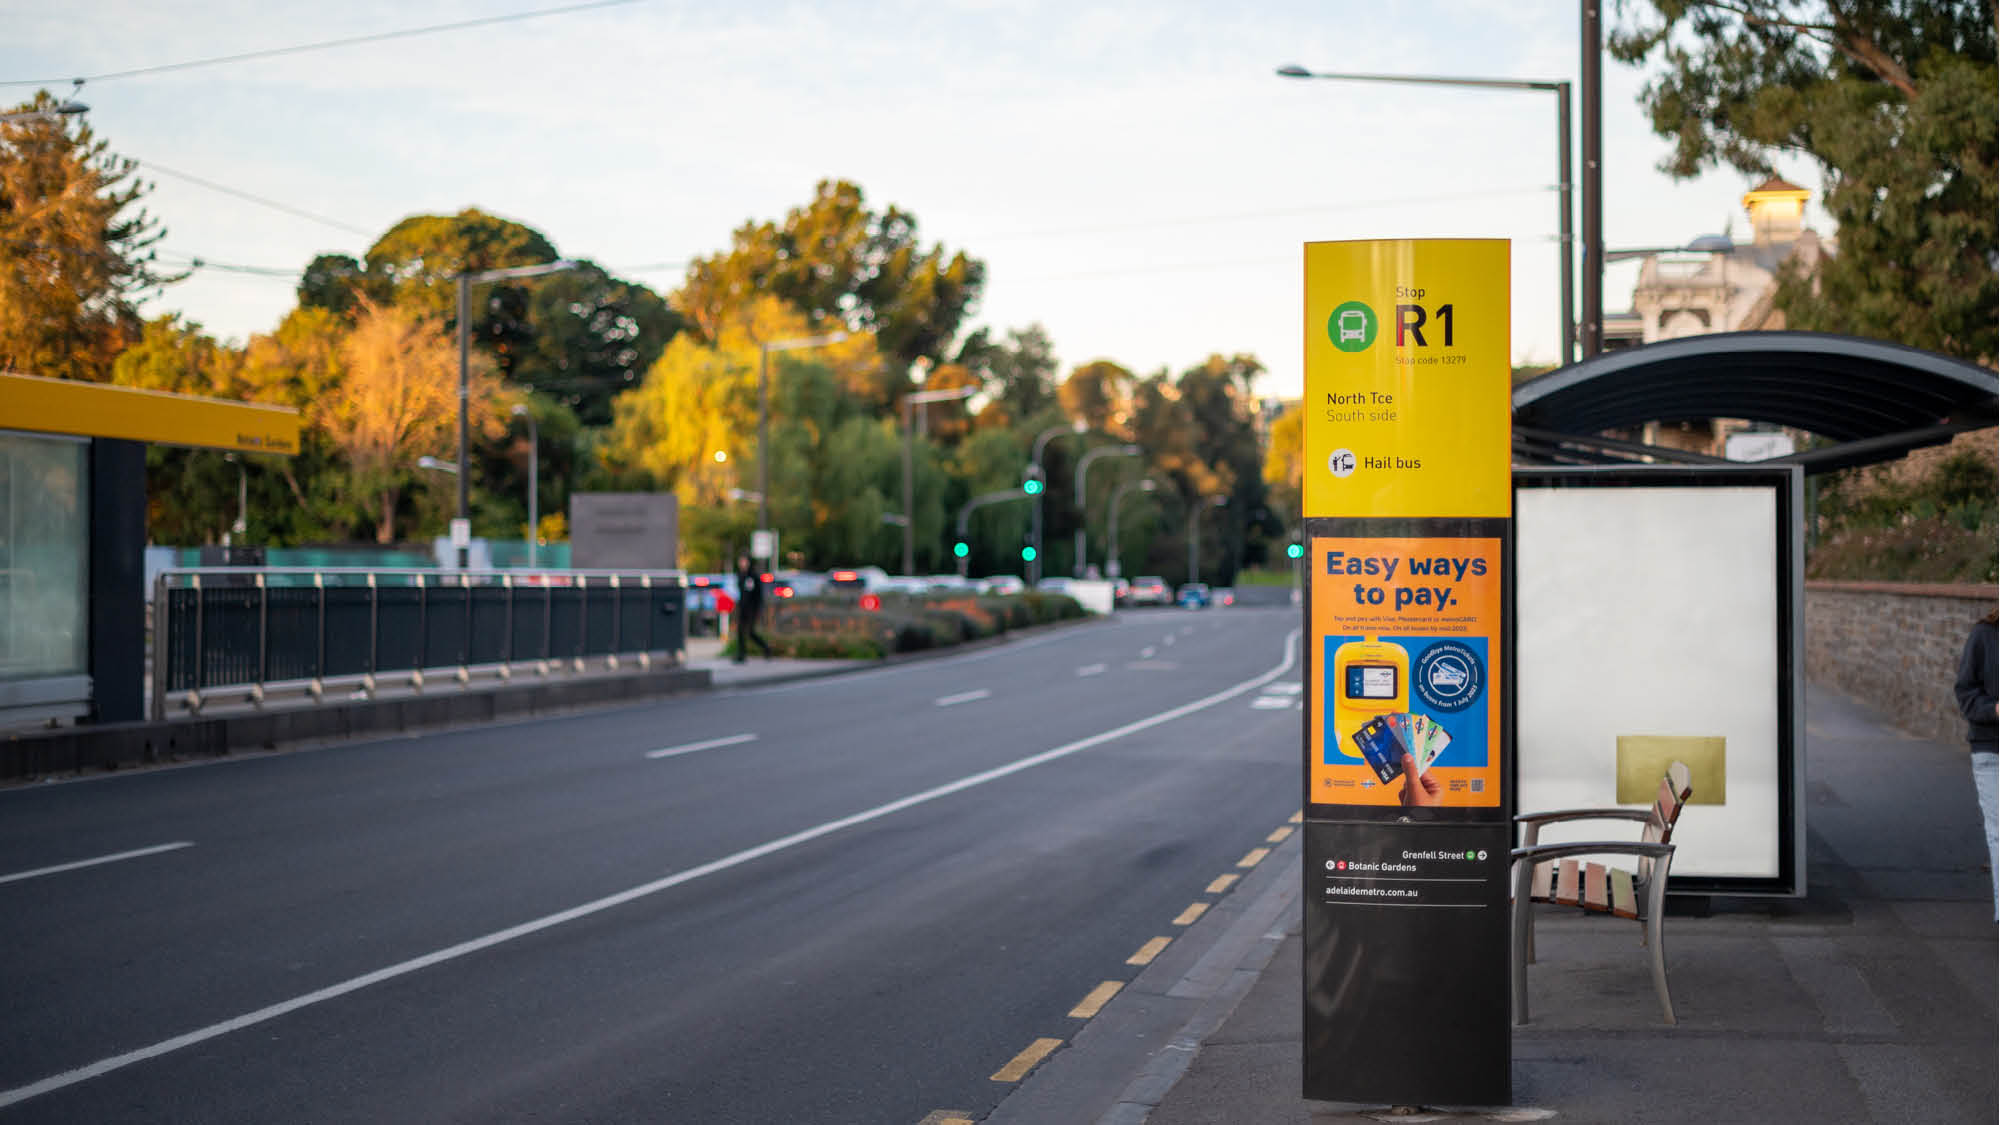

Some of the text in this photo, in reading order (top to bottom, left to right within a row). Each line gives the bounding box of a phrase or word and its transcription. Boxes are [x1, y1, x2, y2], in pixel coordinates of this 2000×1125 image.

[1396, 286, 1425, 300] Stop
[1396, 304, 1453, 347] R1
[1395, 355, 1467, 367] Stop code 13279
[1327, 391, 1393, 405] North Tce
[1327, 408, 1398, 422] South side
[1364, 456, 1422, 469] Hail bus
[1327, 551, 1488, 582] Easy ways
[1353, 584, 1457, 612] to pay.
[1402, 850, 1464, 860] Grenfell Street
[1348, 861, 1417, 872] Botanic Gardens
[1325, 886, 1418, 897] adelaidemetro.com.au
